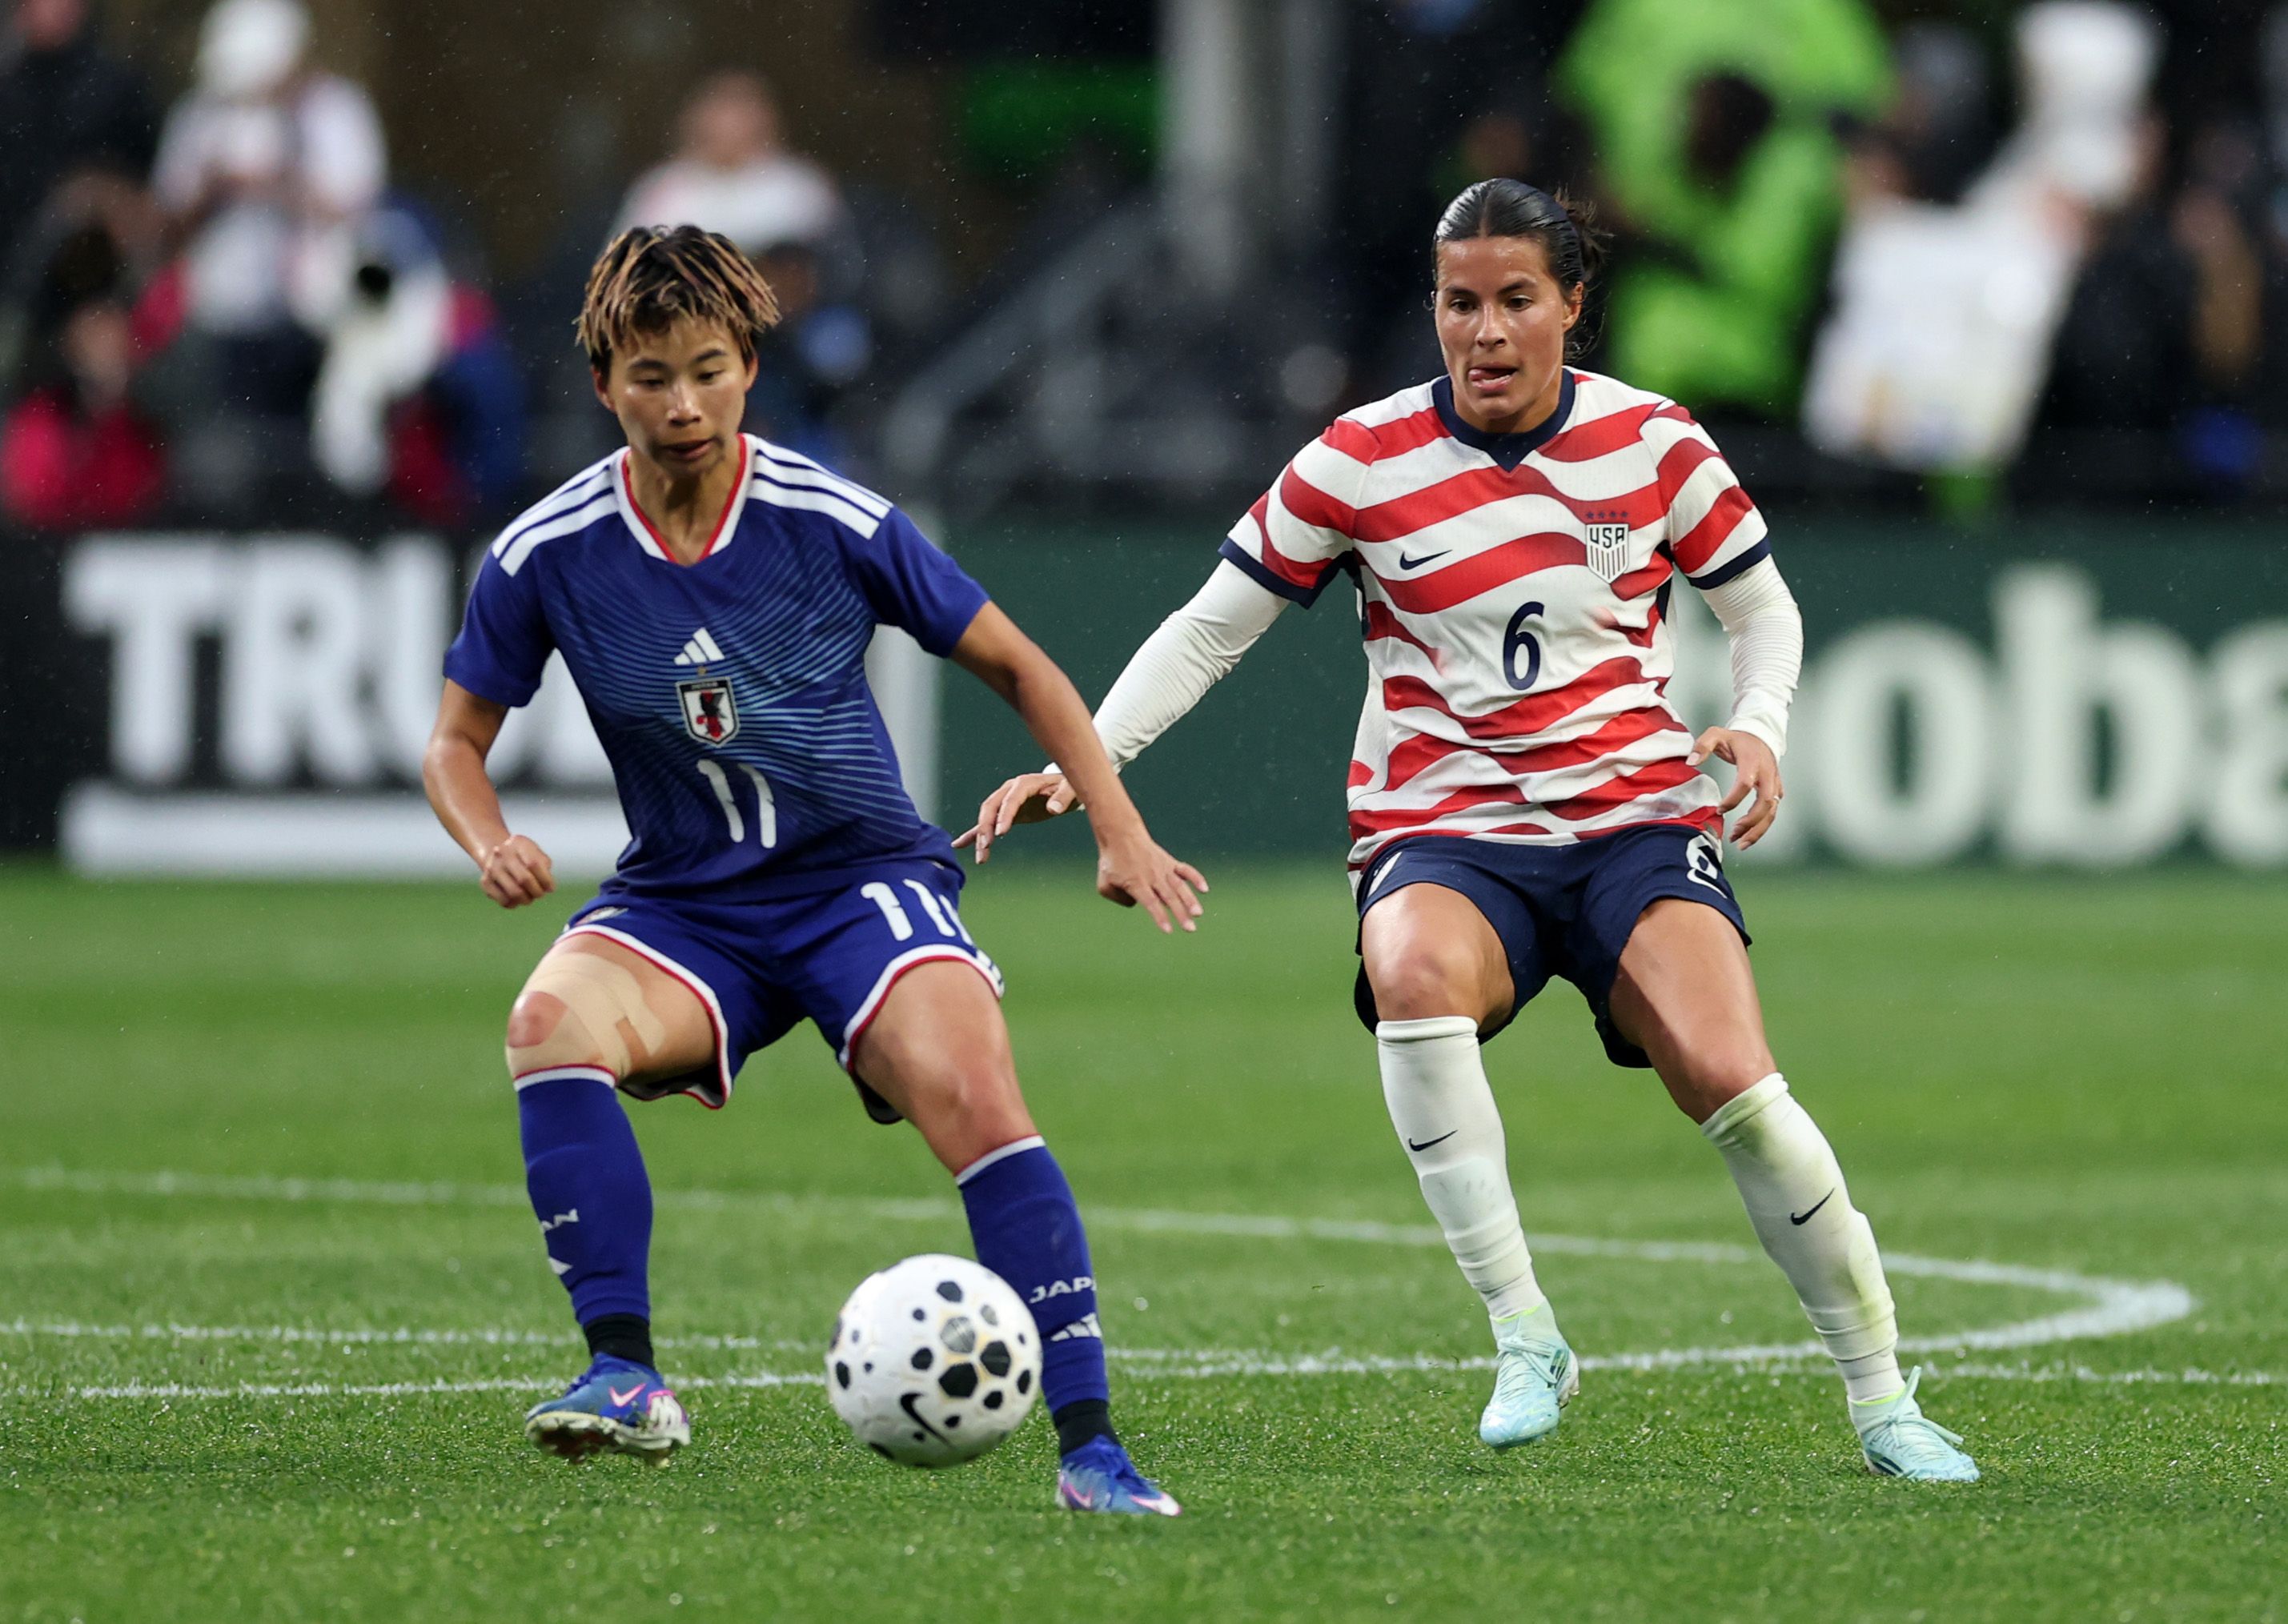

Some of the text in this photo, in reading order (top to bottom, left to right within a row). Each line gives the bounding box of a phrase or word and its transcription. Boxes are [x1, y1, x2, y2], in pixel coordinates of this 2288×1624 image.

[1589, 527, 1625, 549] USA
[1503, 601, 1544, 691] 6
[696, 758, 777, 848] 11
